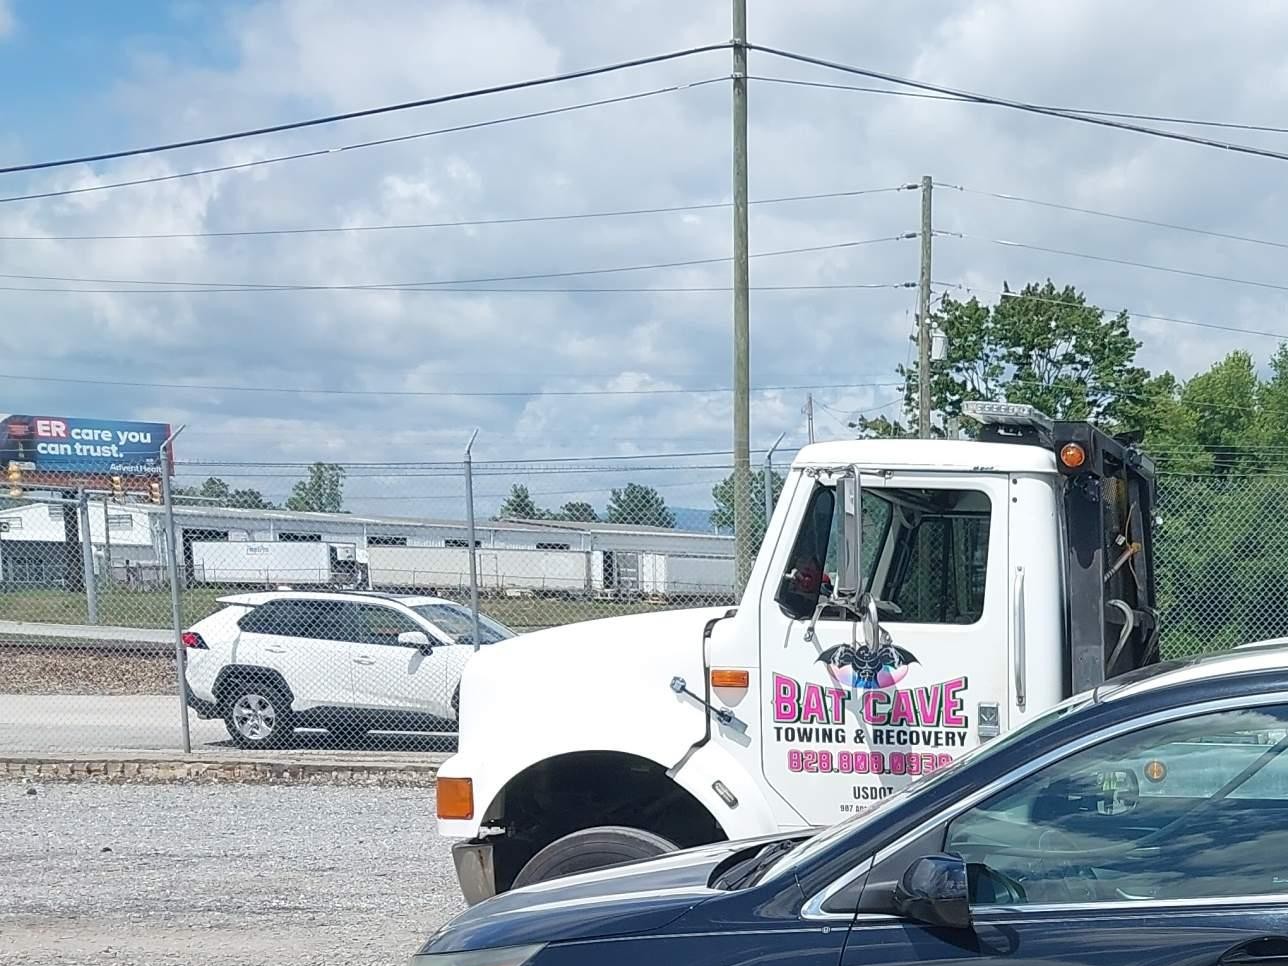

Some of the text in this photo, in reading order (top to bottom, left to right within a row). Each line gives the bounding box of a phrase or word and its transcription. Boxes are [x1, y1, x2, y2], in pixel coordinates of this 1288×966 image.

[36, 420, 152, 446] ER care you
[37, 442, 124, 458] can trust.
[110, 463, 162, 473] AdventHealt
[771, 672, 969, 728] BAT CAVE
[774, 727, 968, 747] TOWING & RECOVERY
[853, 786, 894, 800] USDOT
